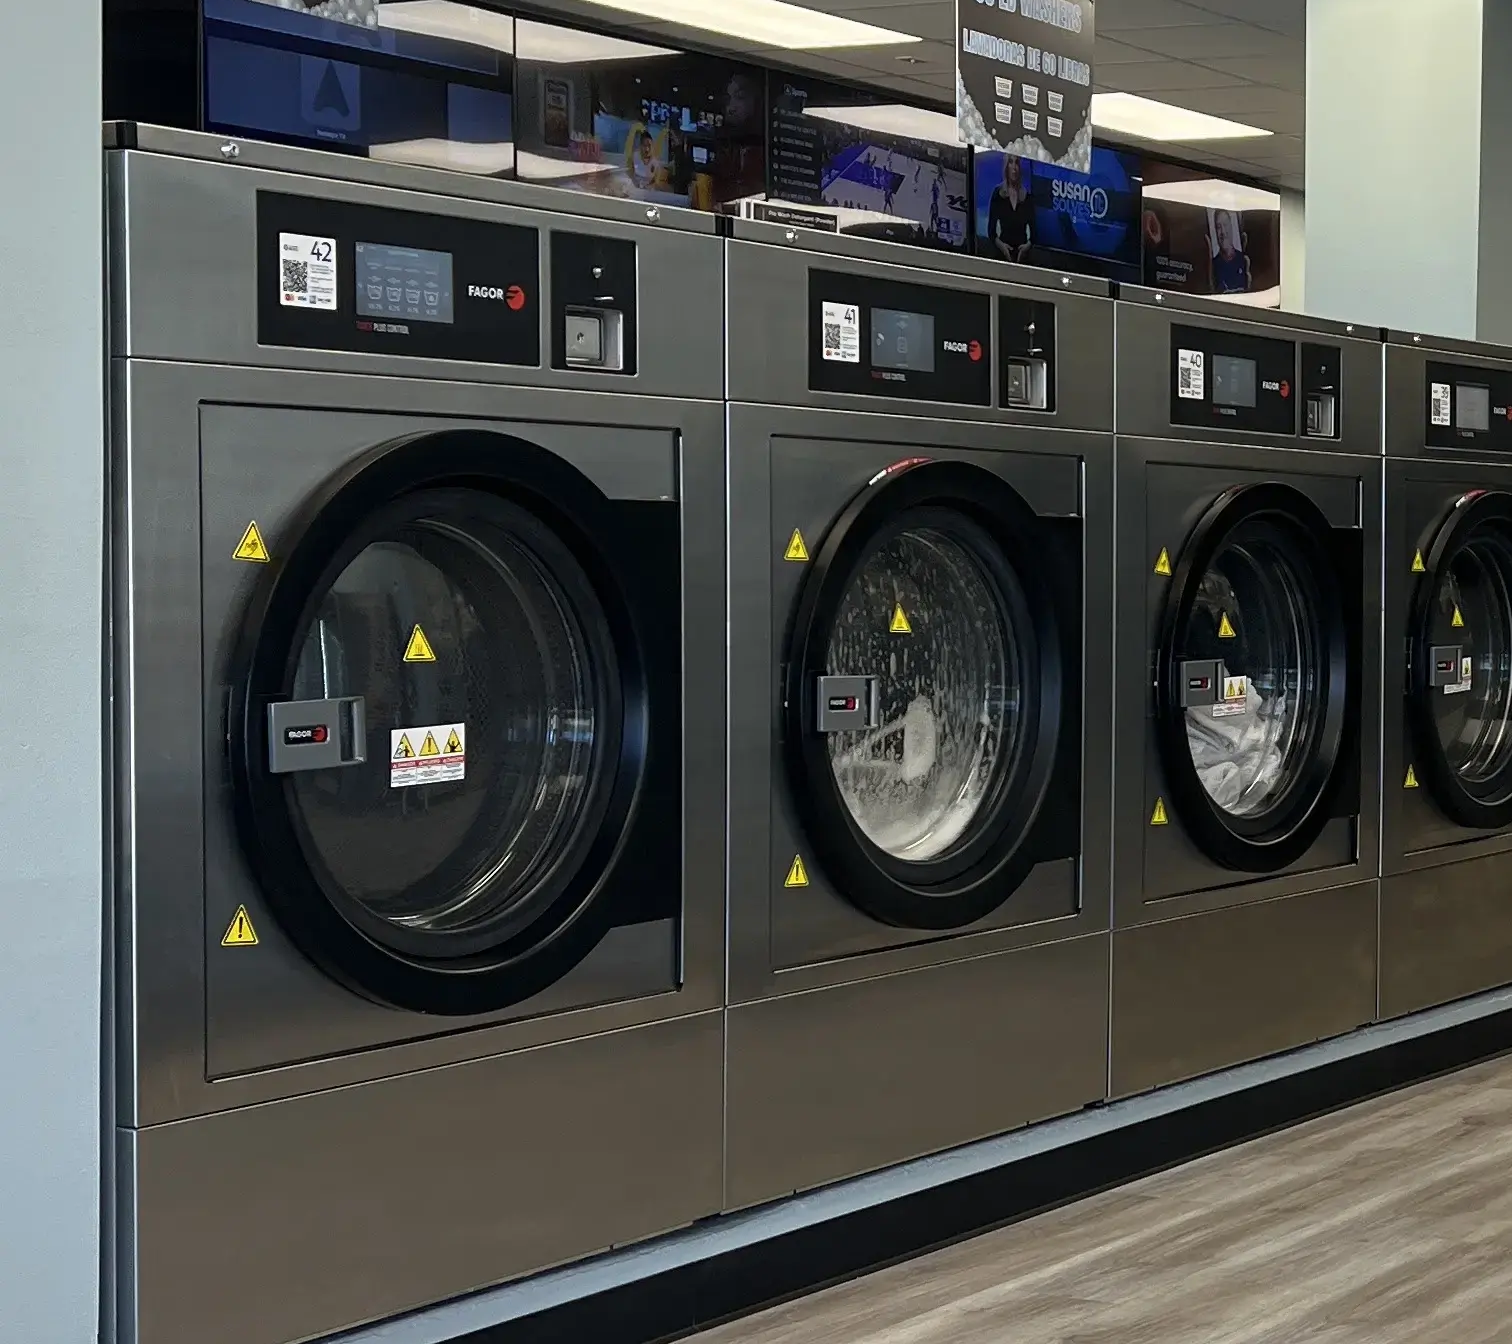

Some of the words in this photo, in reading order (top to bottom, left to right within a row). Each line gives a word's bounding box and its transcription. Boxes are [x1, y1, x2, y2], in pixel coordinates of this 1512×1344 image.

[962, 27, 1026, 67] LAVADORAS
[1026, 45, 1041, 72] DE
[1041, 51, 1057, 77] 60
[1057, 55, 1090, 87] LIBRAS
[1052, 178, 1090, 203] SUSAN
[309, 241, 332, 263] 42
[467, 285, 504, 300] FAGOR
[844, 308, 855, 325] 41
[943, 340, 968, 353] FAGOR
[1189, 353, 1202, 368] 40
